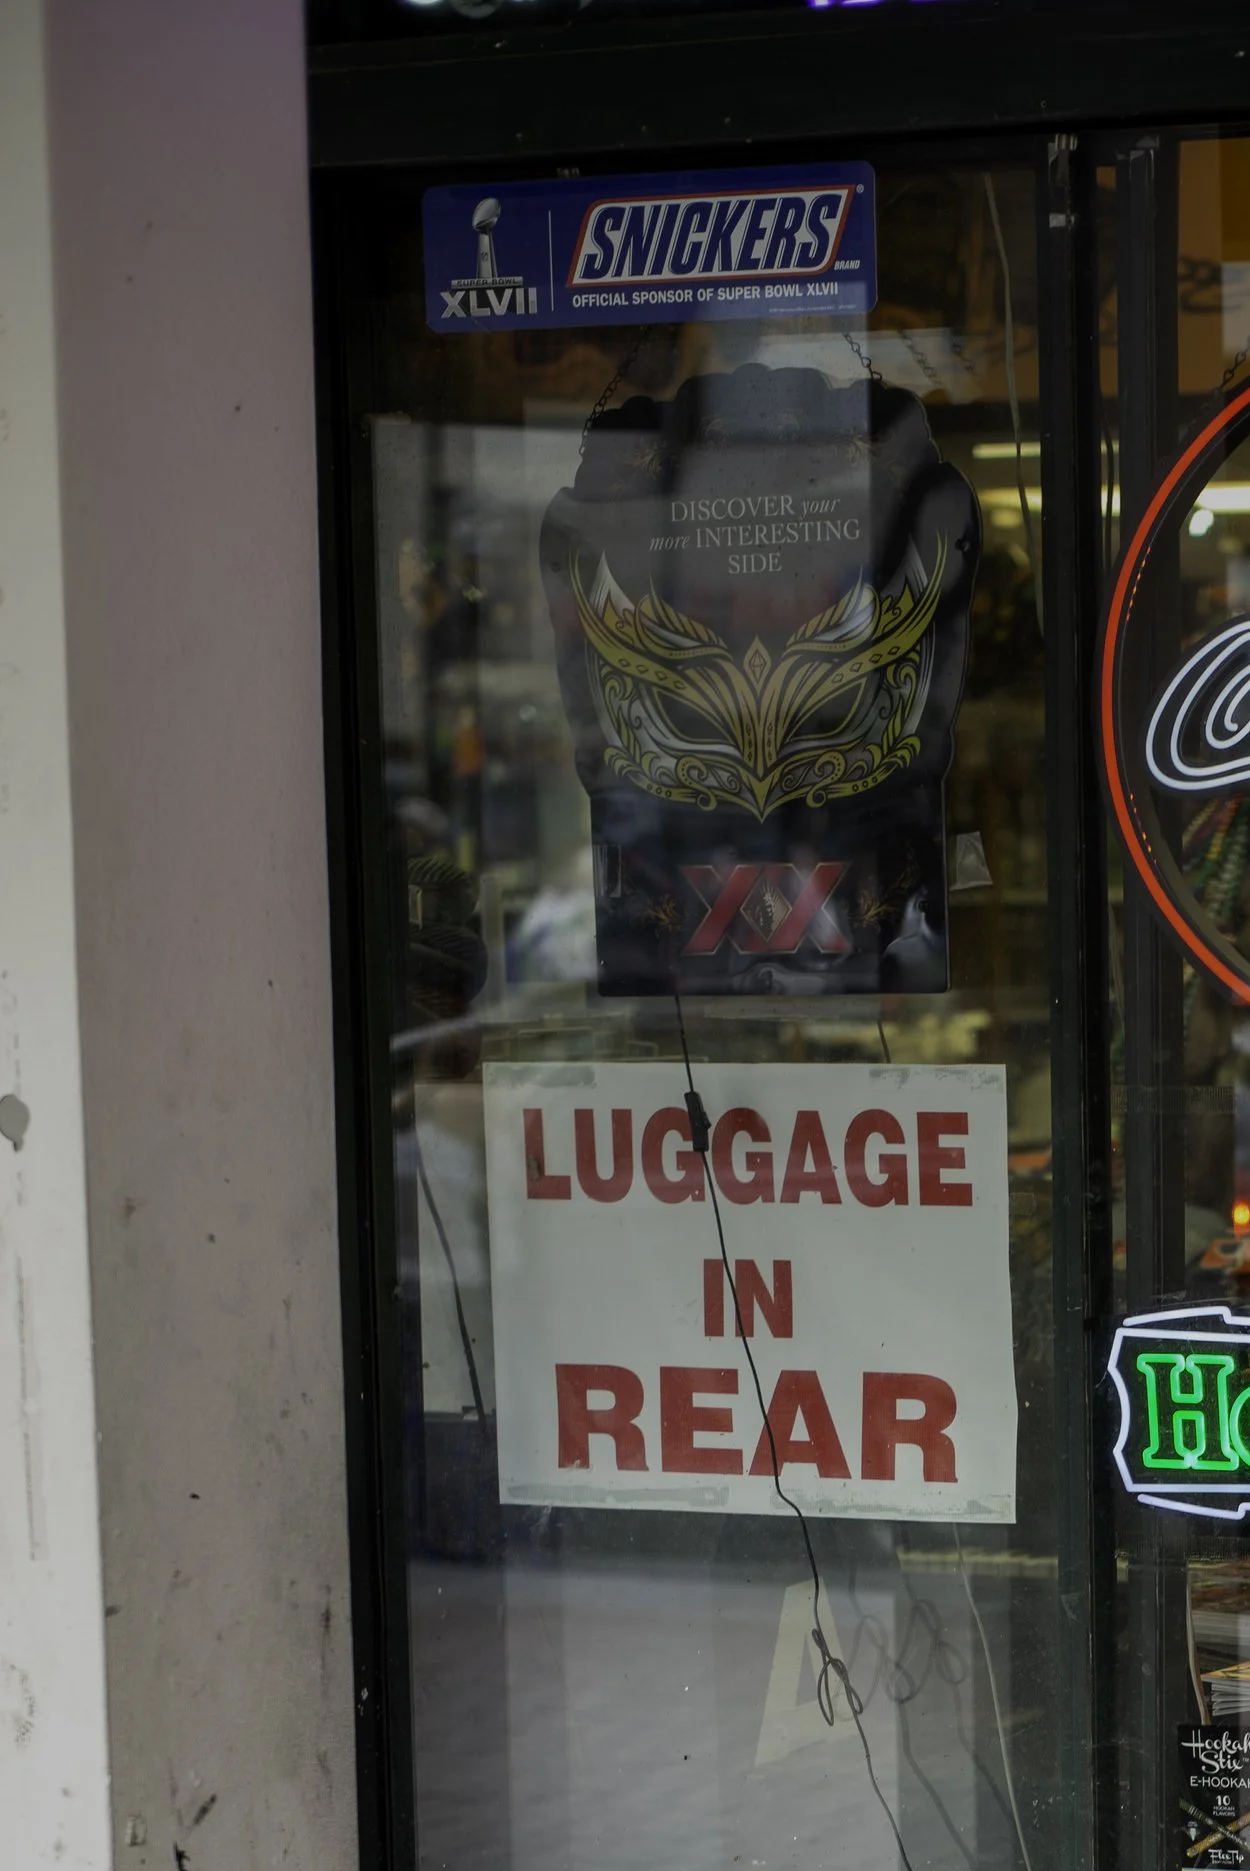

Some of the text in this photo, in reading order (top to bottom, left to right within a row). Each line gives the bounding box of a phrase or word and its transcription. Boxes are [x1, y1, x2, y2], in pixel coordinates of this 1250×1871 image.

[579, 194, 844, 279] SNICKERS
[833, 259, 861, 271] BRAND
[457, 276, 521, 287] SUPER BOWL
[572, 281, 839, 308] OFFICIAL SPONSOR OF SUPER BOWL XLVII
[440, 286, 538, 319] XLVII
[670, 496, 841, 524] DISCOVER your
[649, 518, 862, 551] more INTERESTING
[727, 552, 783, 575] SIDE
[679, 860, 854, 956] XX
[523, 1107, 973, 1208] LUGGAGE
[702, 1258, 794, 1339] IN
[555, 1363, 959, 1483] REAR
[1202, 1751, 1244, 1774] Stix
[1215, 1795, 1231, 1806] 10
